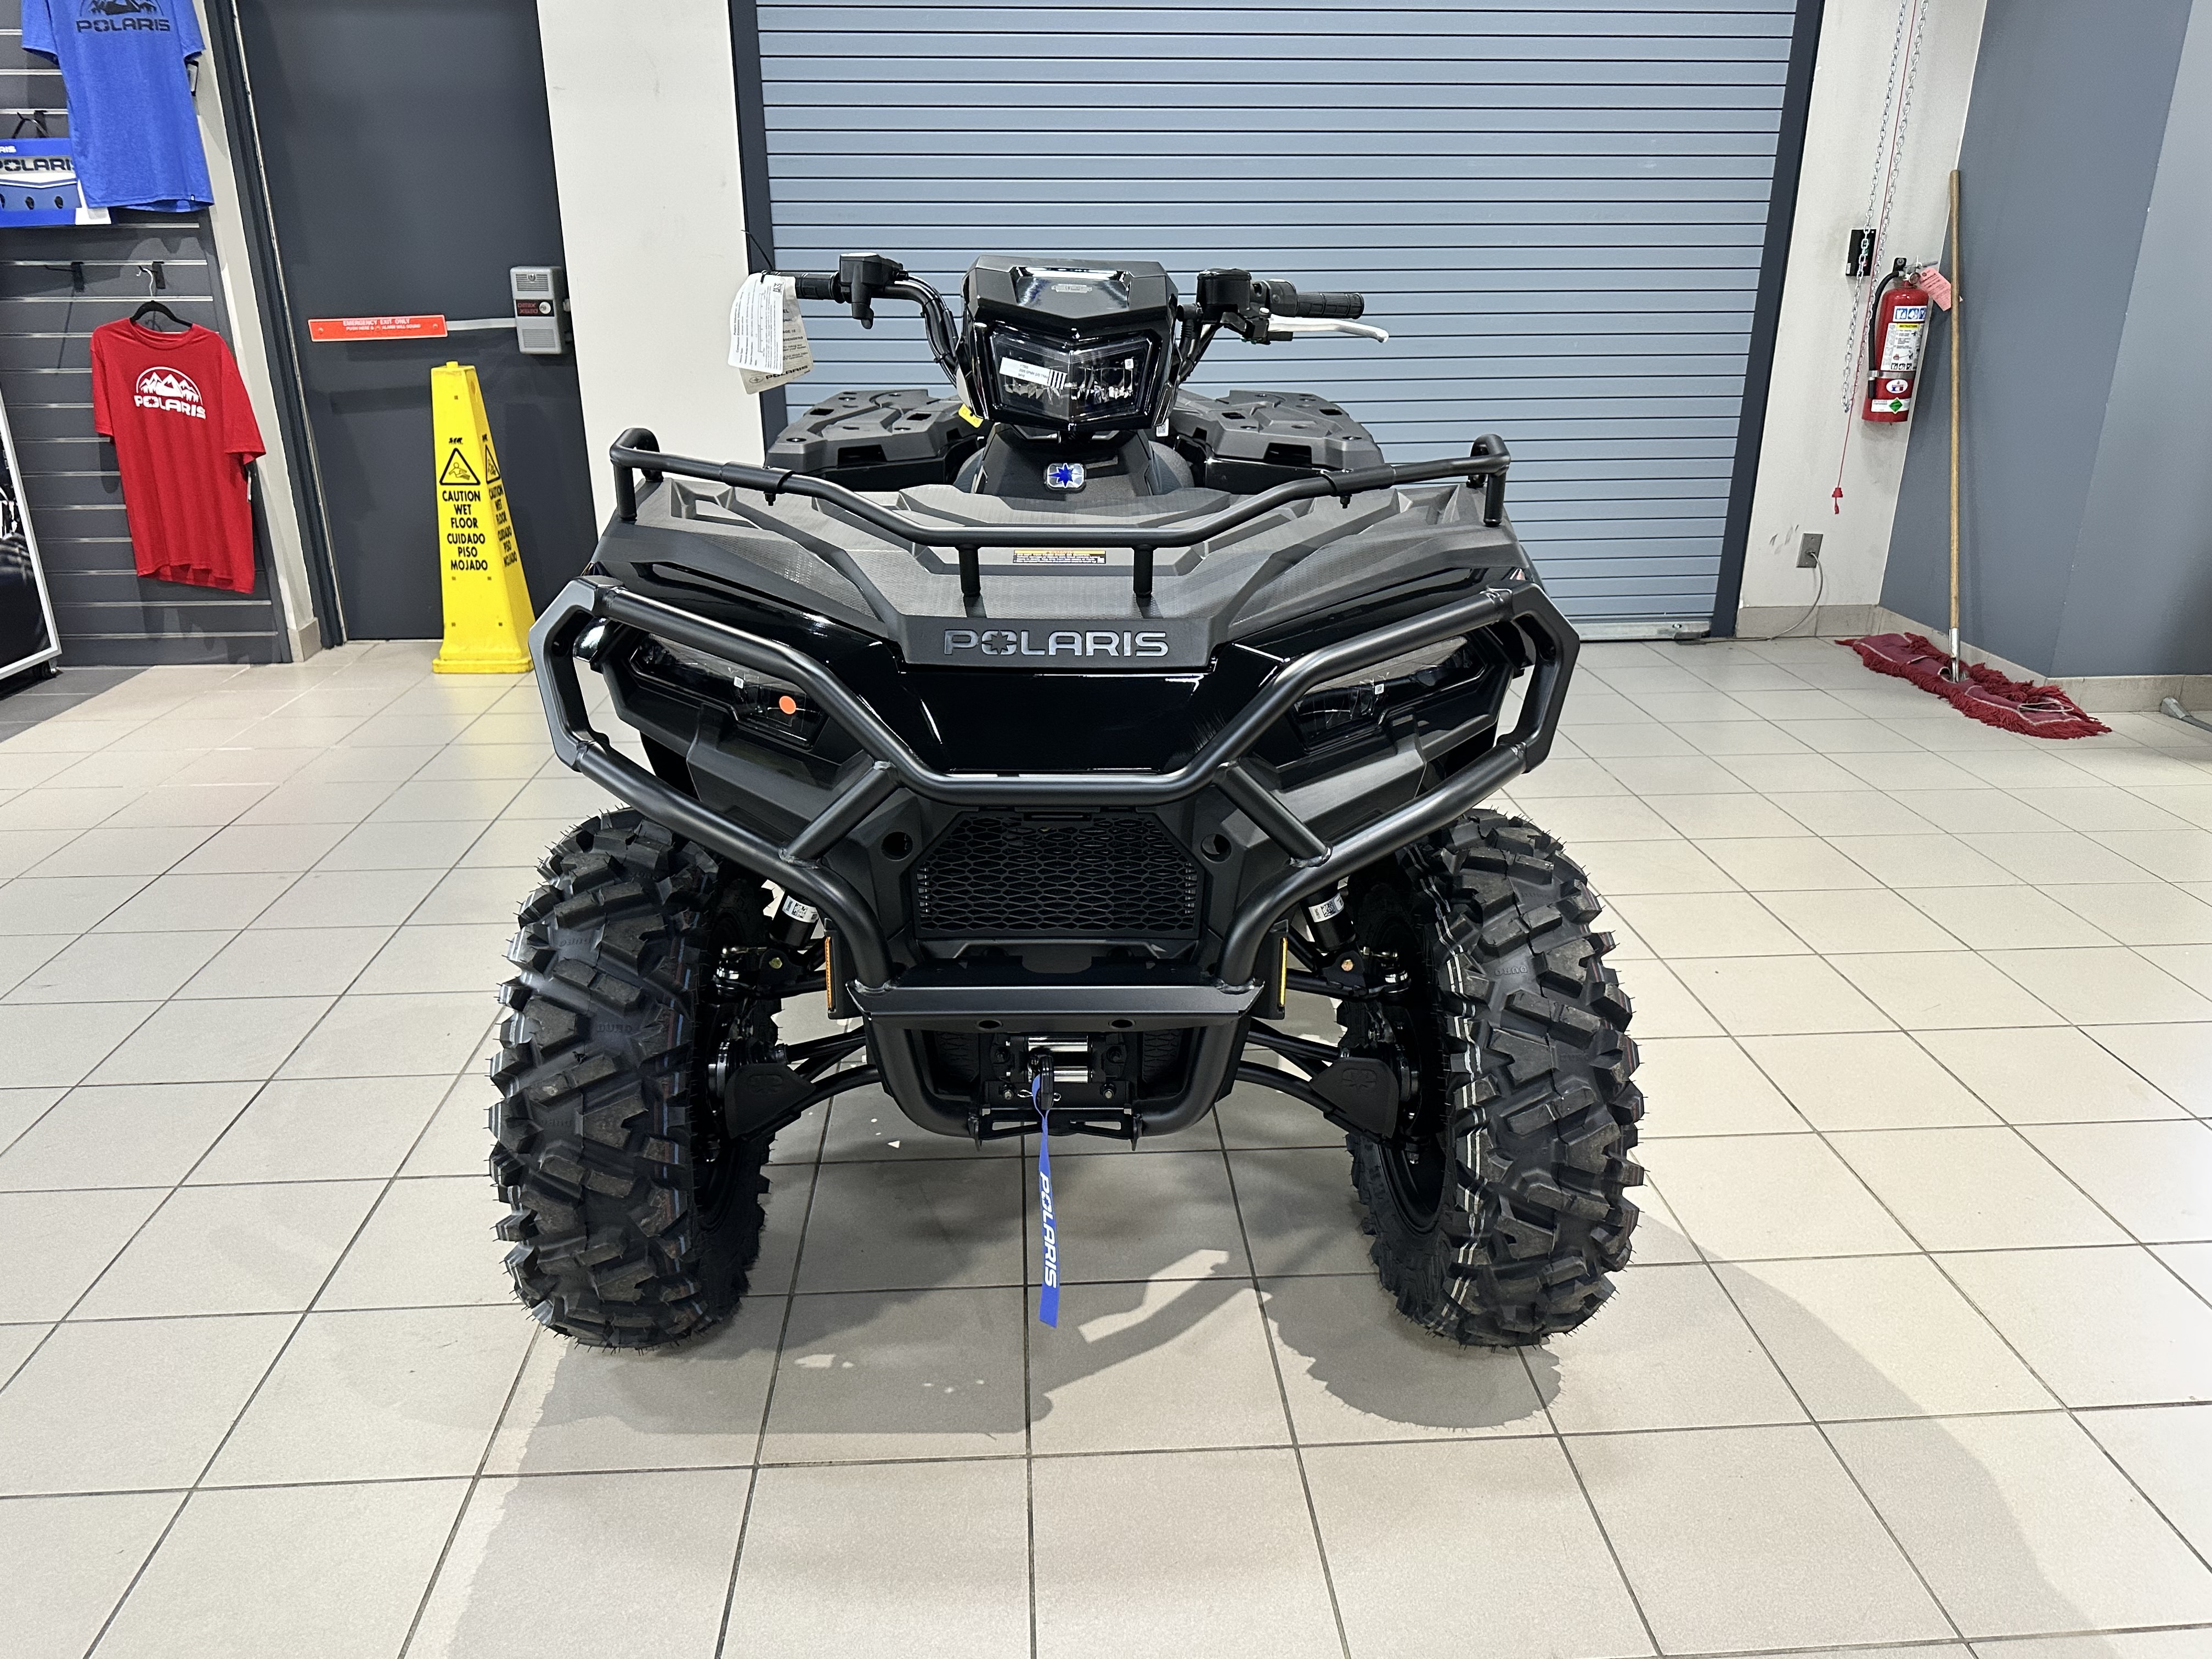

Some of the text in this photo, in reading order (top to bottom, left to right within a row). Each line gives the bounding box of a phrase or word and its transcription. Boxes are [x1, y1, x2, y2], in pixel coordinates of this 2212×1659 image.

[76, 18, 171, 32] POLARIS
[0, 158, 75, 172] OLARI
[134, 395, 206, 419] POLARIS
[442, 490, 481, 501] CAUTION
[454, 504, 471, 515] WET
[451, 517, 478, 529] FLOOR
[447, 533, 486, 544] CUIDADO
[458, 546, 478, 557] PISO
[451, 560, 488, 571] MOJADO
[944, 629, 1169, 657] POLARIS
[1494, 966, 1527, 977] DURO
[596, 1024, 633, 1033] DURO
[1040, 1171, 1057, 1288] POLARIS
